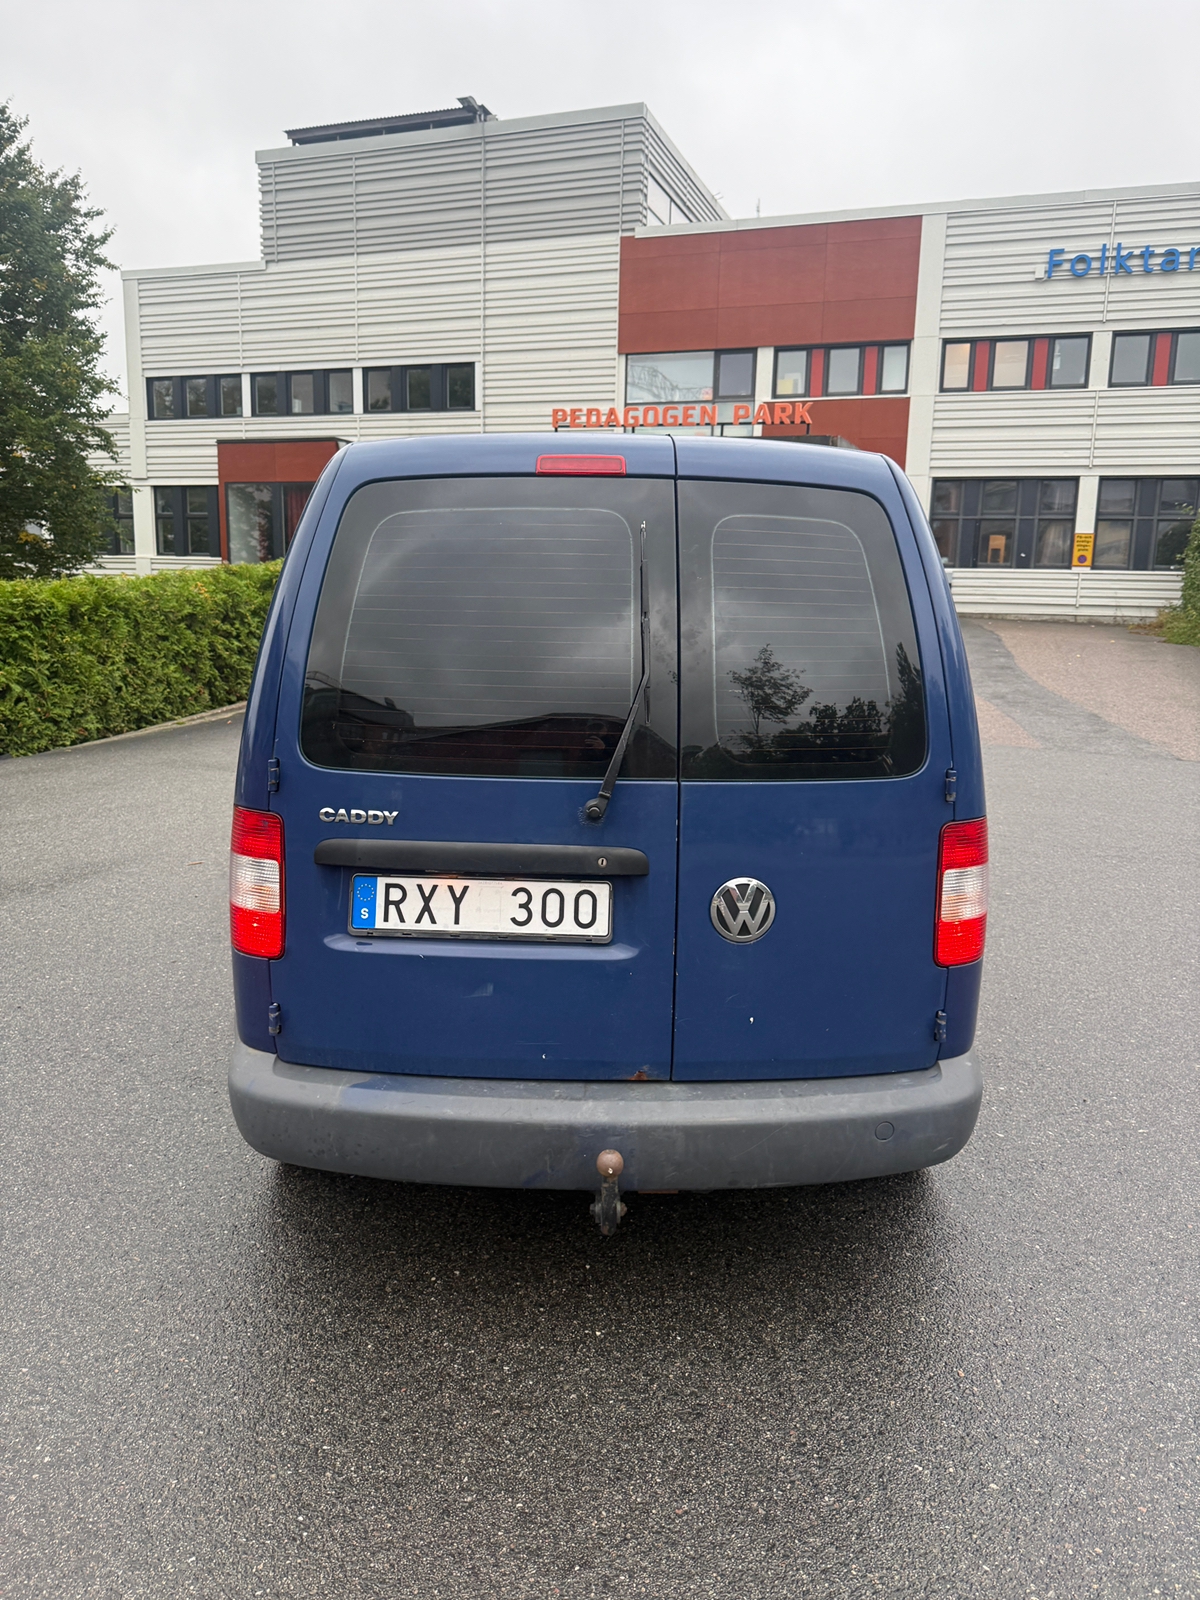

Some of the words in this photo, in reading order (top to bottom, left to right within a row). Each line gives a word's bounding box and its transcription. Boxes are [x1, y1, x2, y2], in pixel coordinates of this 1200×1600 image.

[552, 404, 718, 428] PEDAGOGEN
[732, 402, 814, 426] PARK
[319, 807, 399, 826] CADDY
[360, 907, 369, 919] S
[383, 882, 470, 925] RXY
[510, 886, 598, 929] 300
